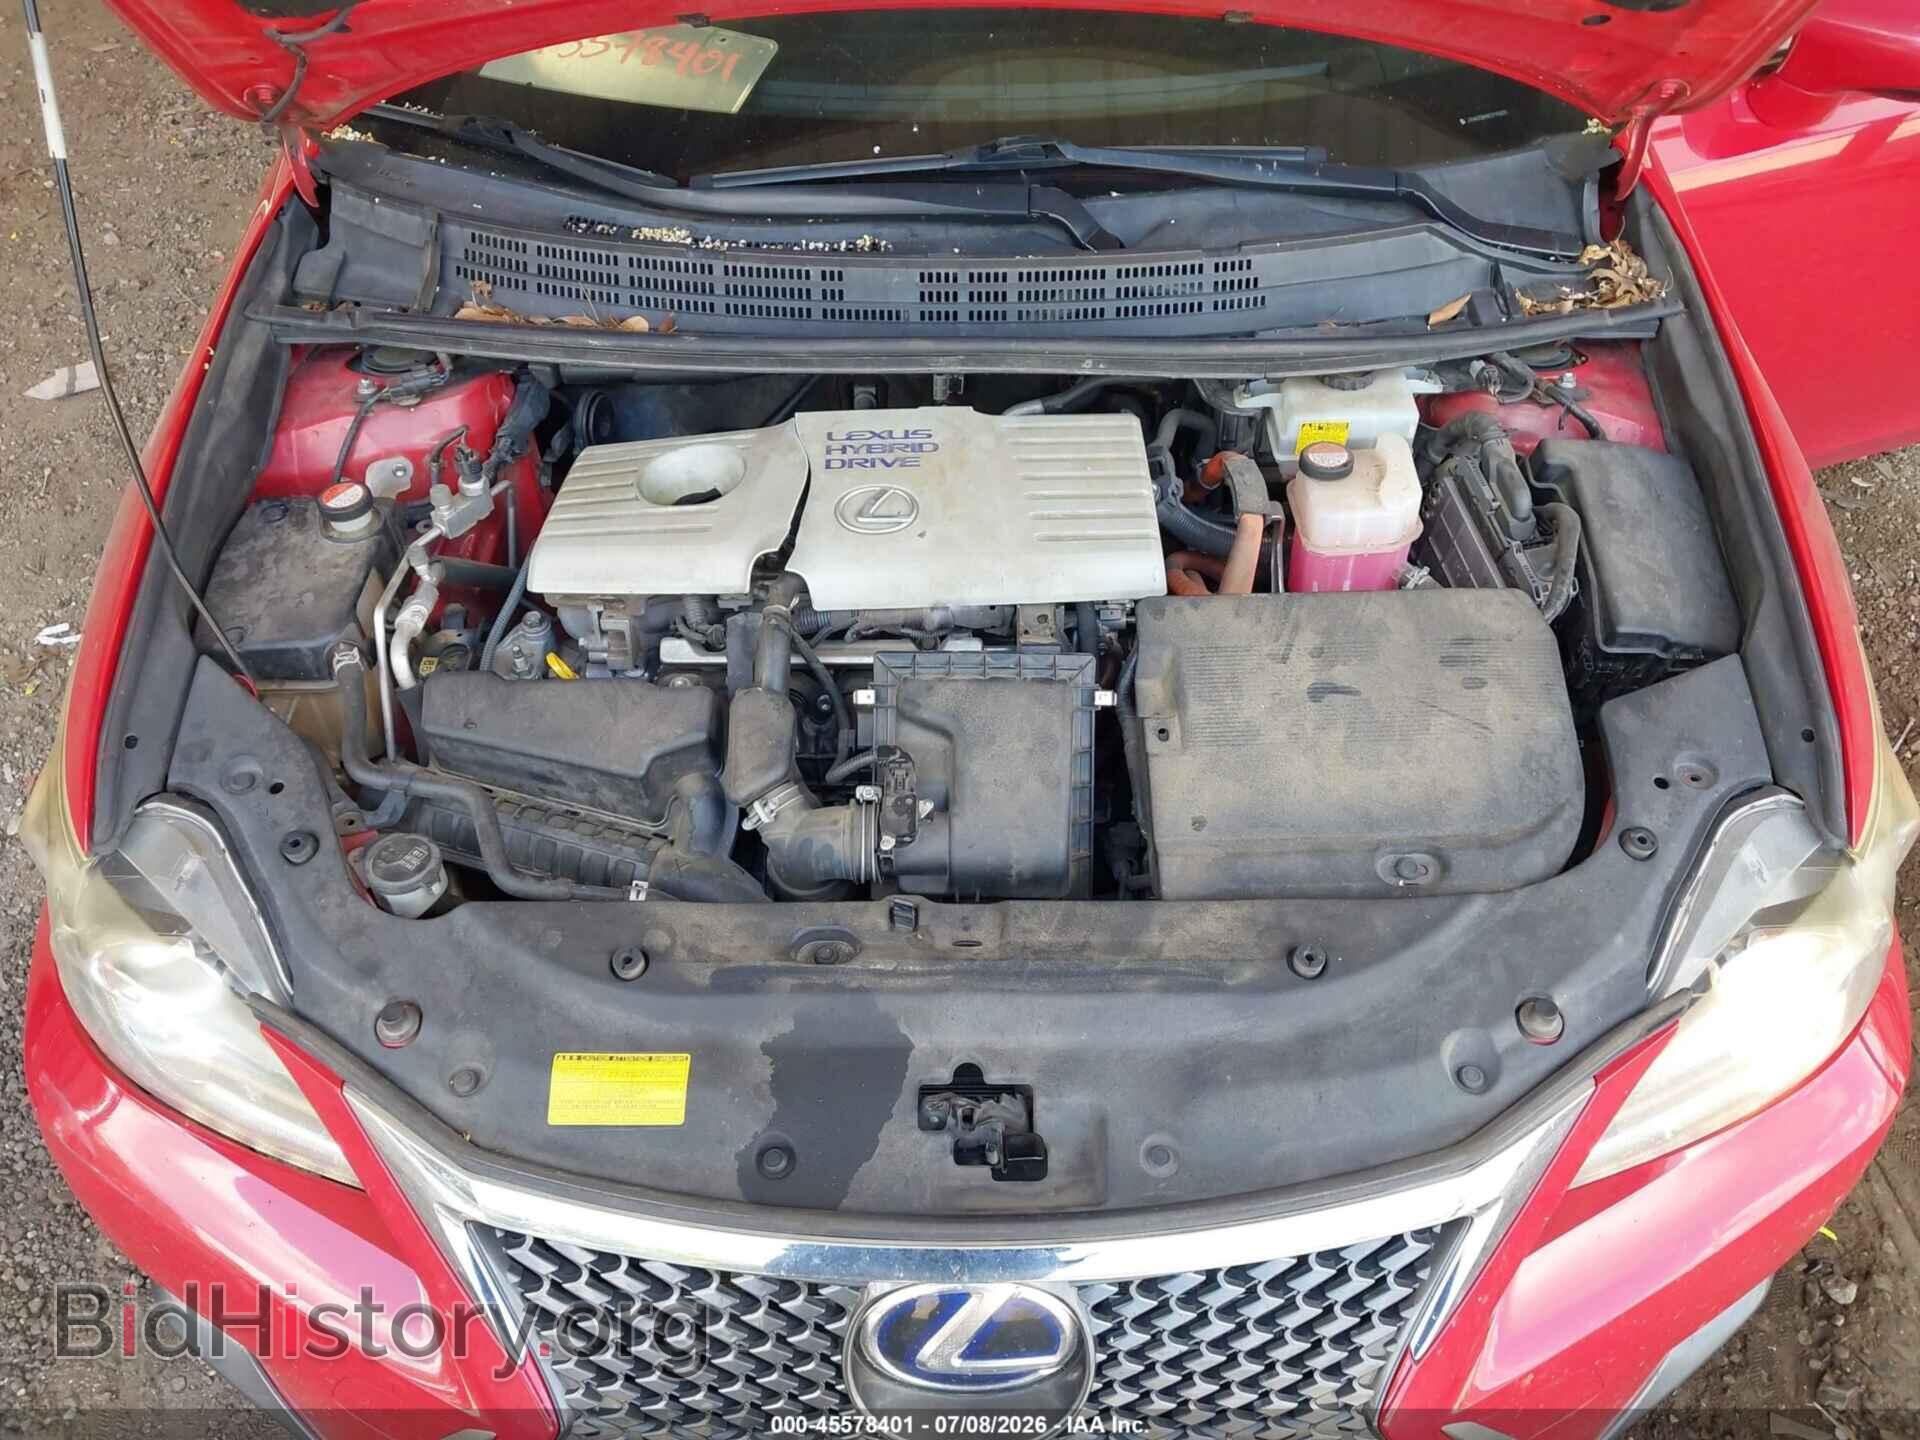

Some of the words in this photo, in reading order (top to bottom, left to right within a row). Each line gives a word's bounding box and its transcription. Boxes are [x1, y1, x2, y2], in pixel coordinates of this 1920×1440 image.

[826, 429, 933, 441] LEXUS
[825, 442, 939, 455] HYBRID
[824, 456, 921, 469] DRIVE
